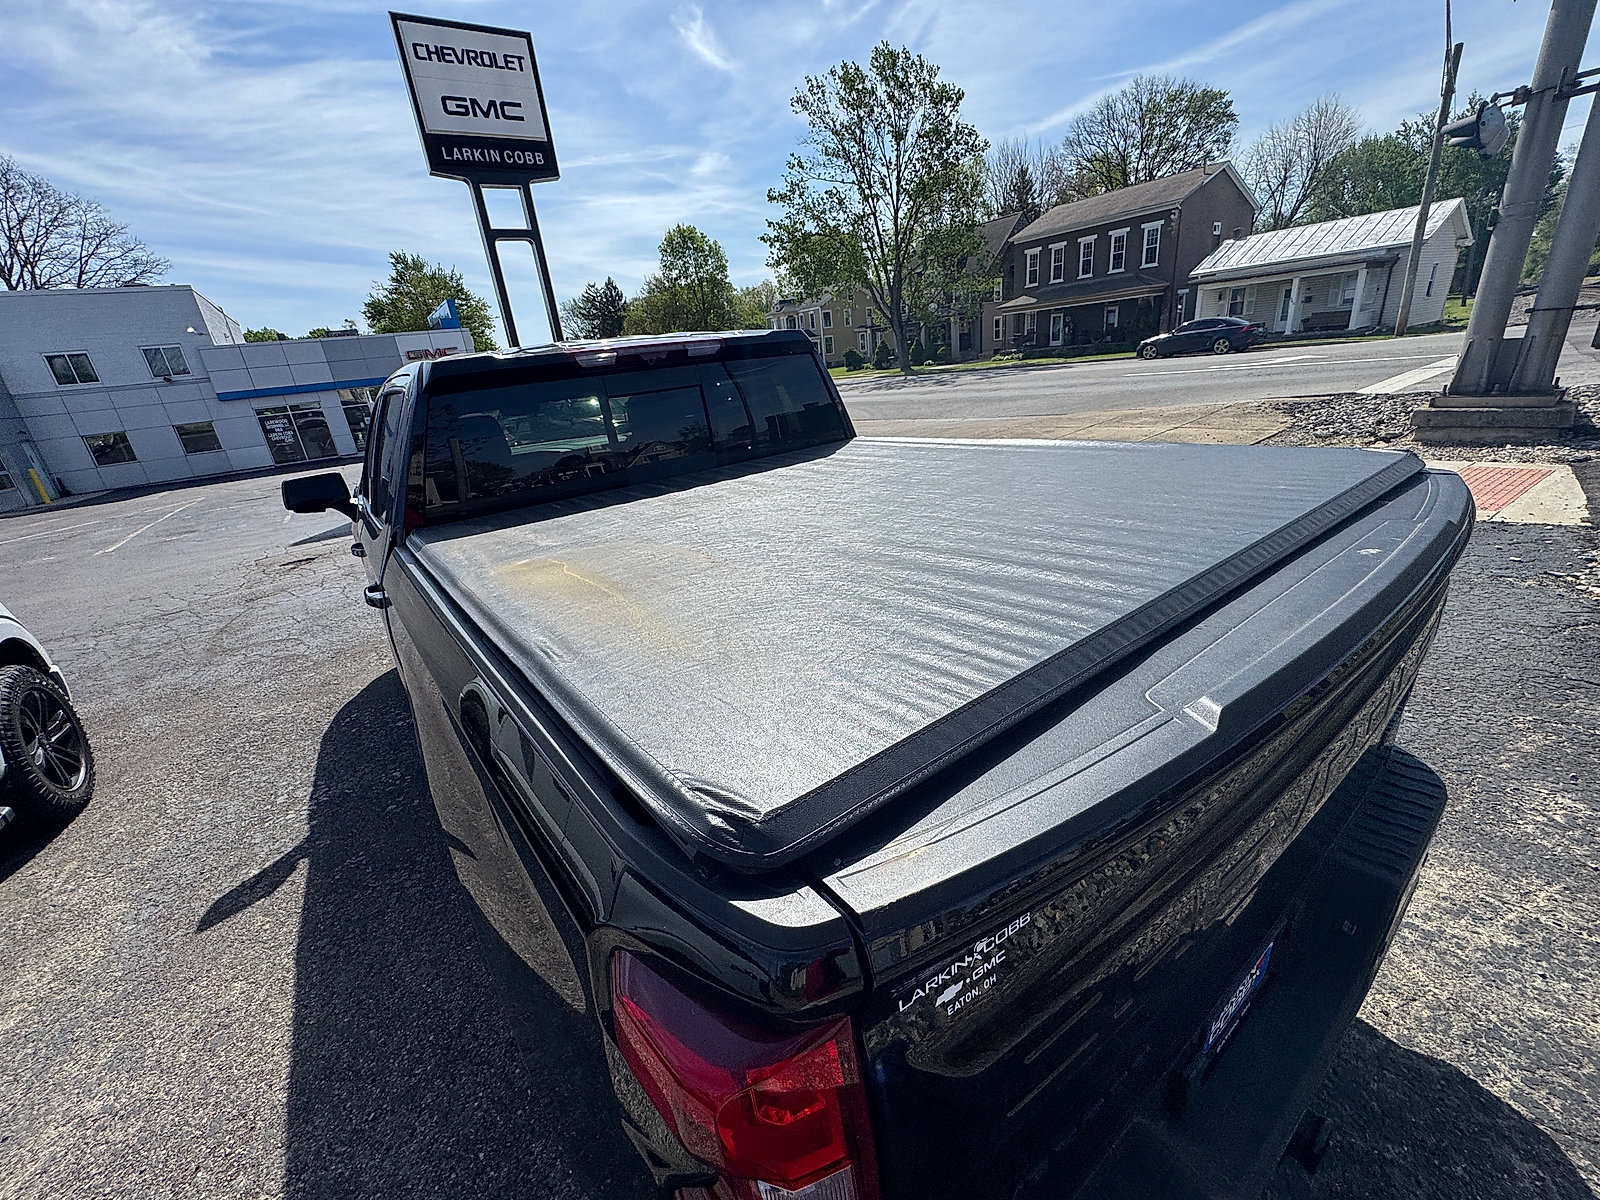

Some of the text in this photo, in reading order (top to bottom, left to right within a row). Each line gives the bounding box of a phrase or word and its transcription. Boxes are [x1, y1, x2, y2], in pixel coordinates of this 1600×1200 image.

[411, 42, 525, 73] CHEVROLET
[440, 95, 525, 122] GMC
[441, 146, 545, 165] LARKIN COBB
[406, 346, 459, 360] GMC
[899, 912, 1031, 1012] LARKIN COBB
[972, 950, 1006, 980] GMC
[947, 973, 997, 1016] EATON, OH
